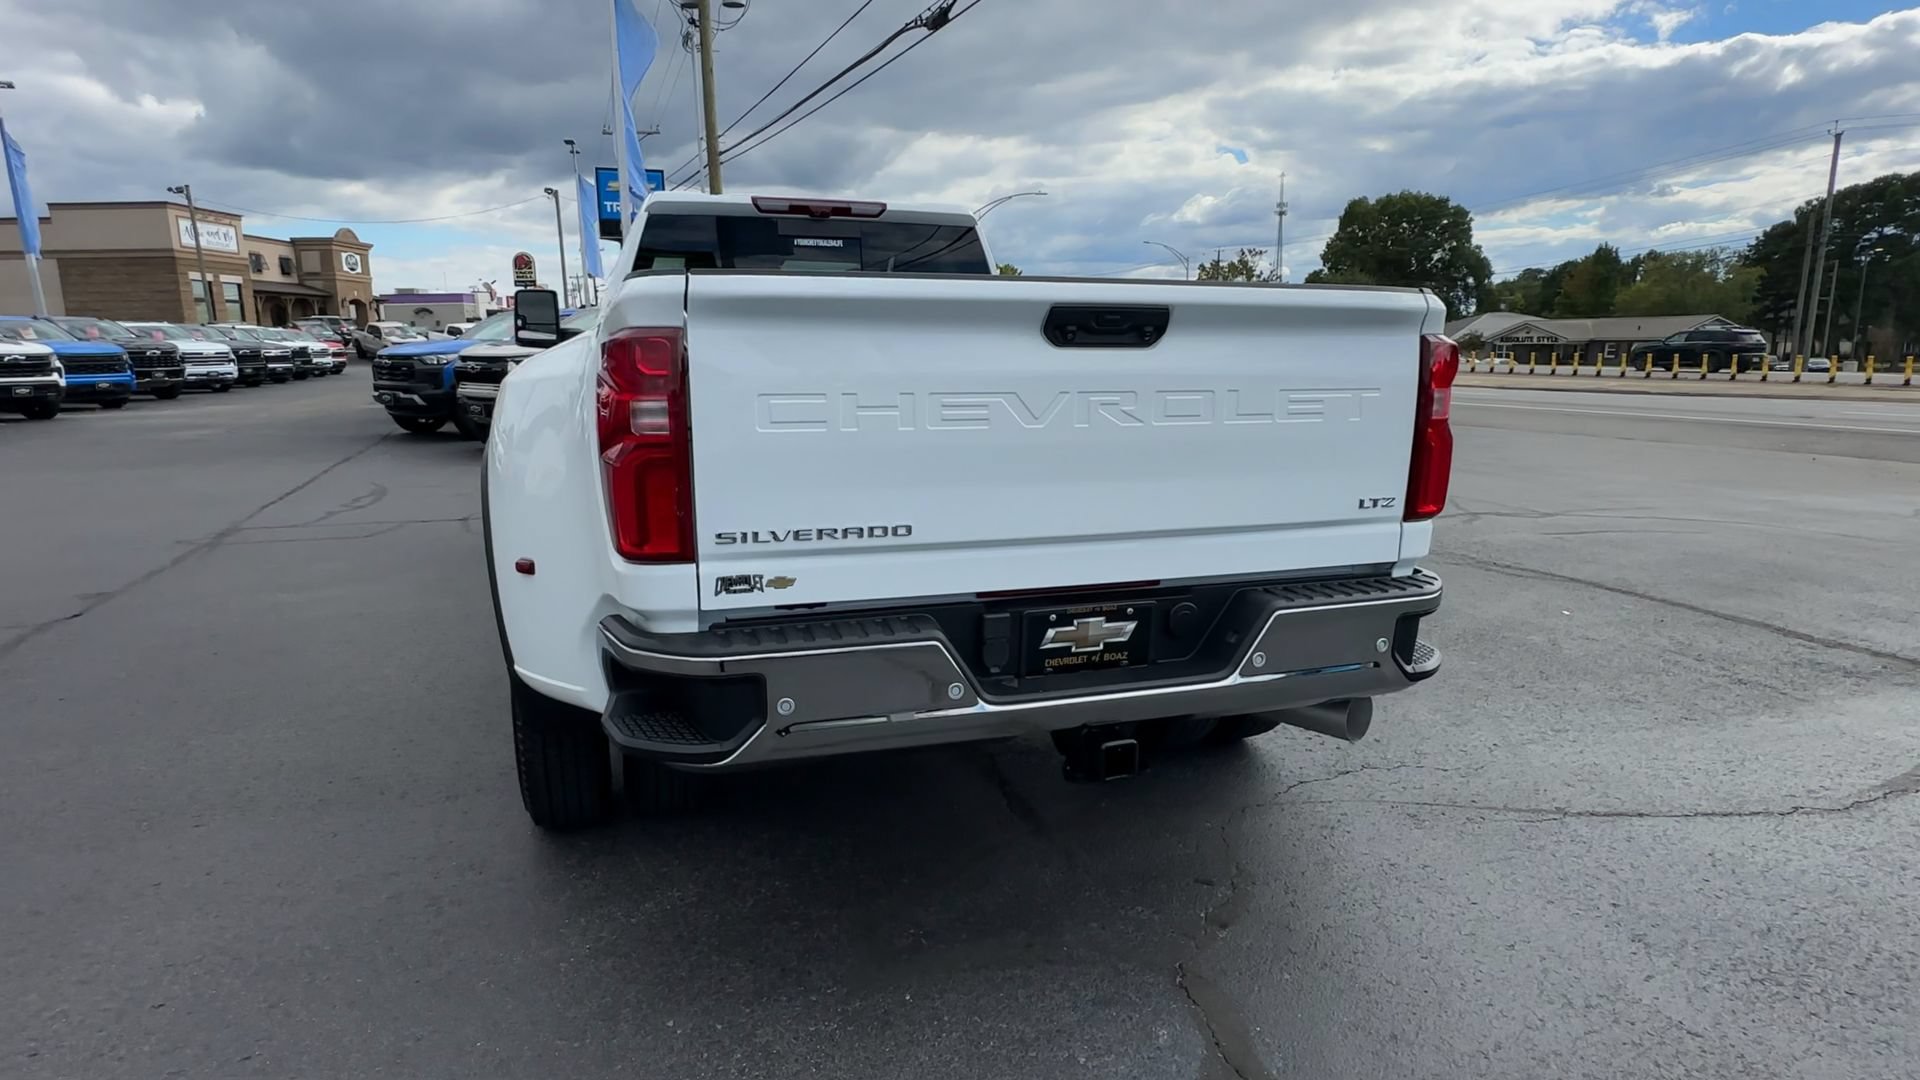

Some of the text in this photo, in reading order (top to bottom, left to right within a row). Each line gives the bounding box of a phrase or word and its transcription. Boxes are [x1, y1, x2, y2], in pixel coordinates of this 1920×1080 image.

[757, 388, 1382, 433] CHEVROLET
[1358, 497, 1396, 510] LTZ
[714, 524, 913, 545] SILVERADO
[714, 574, 764, 597] CHEVROLET
[1045, 655, 1088, 668] CHEVROLET
[1103, 651, 1128, 662] BOAZ
